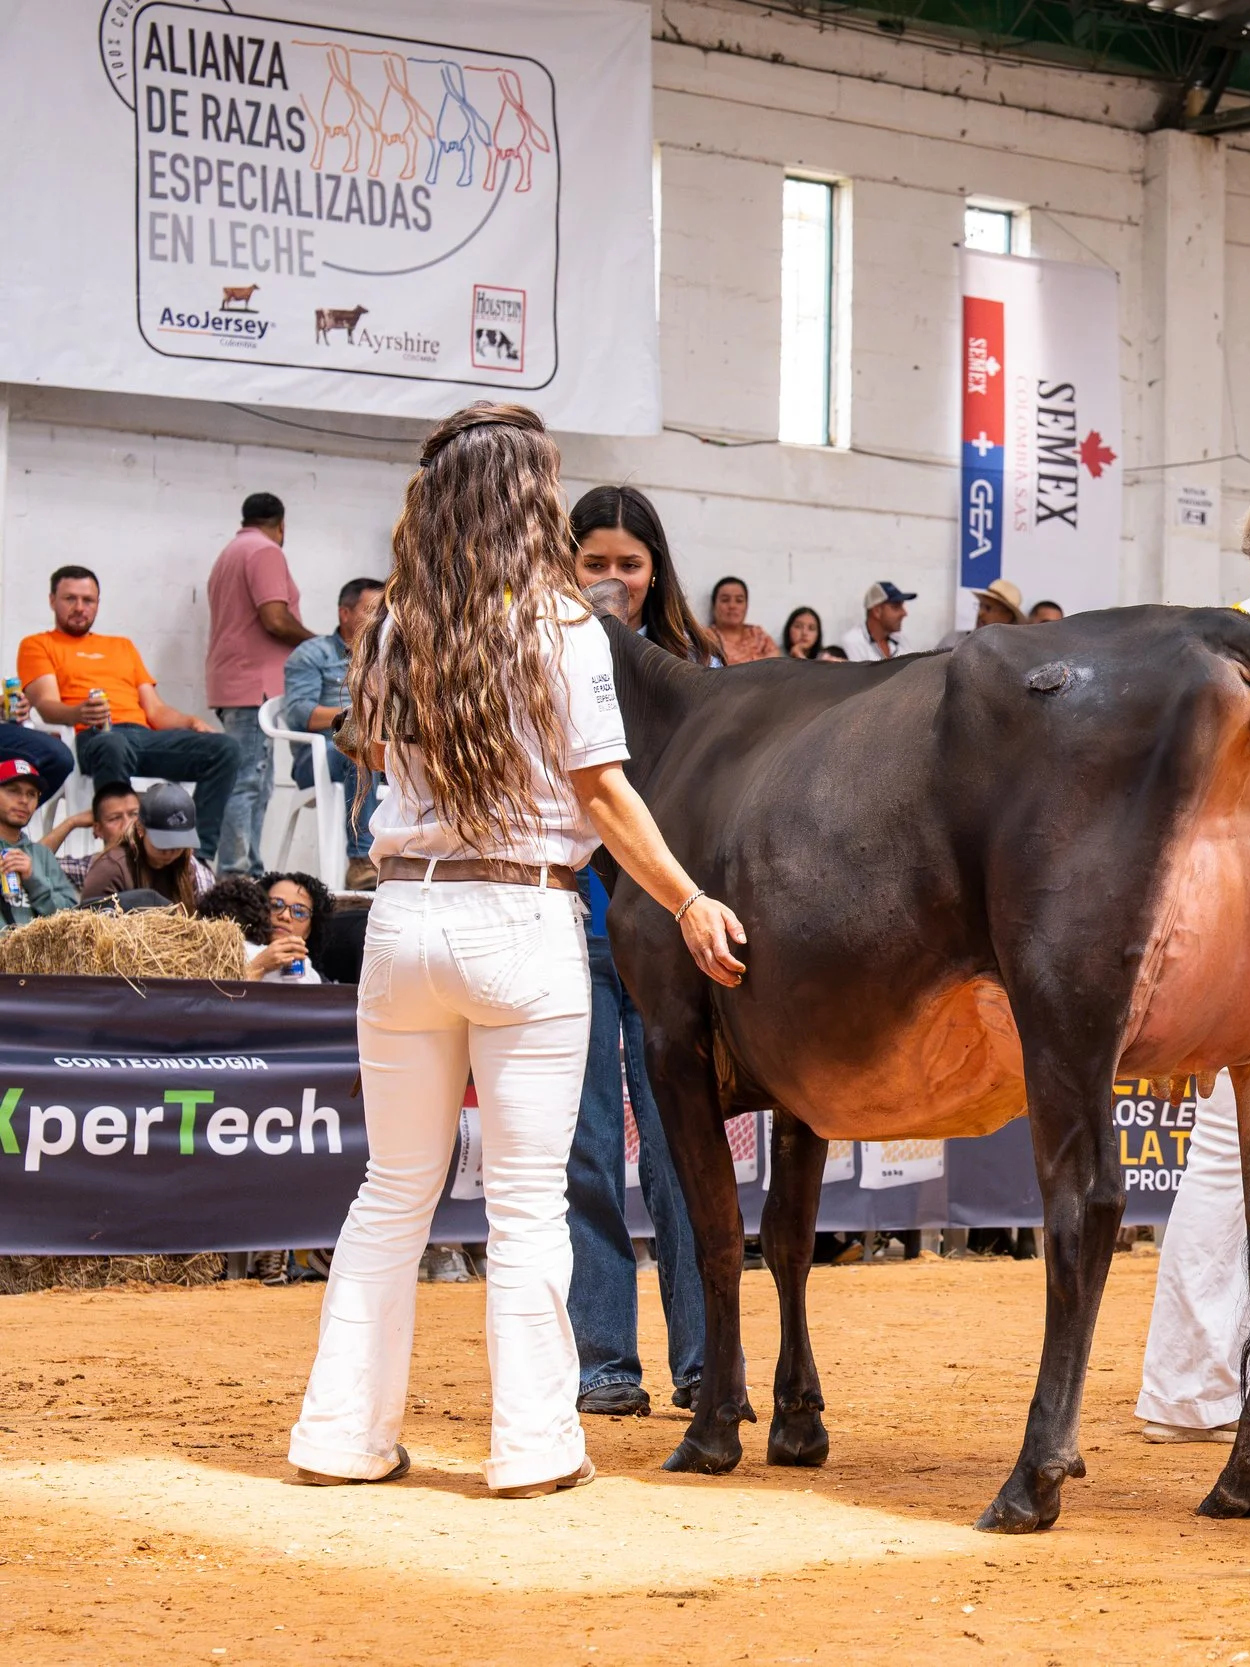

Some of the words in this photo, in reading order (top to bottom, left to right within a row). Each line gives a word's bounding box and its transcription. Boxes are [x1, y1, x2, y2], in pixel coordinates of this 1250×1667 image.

[143, 21, 289, 91] ALIANZA
[146, 85, 189, 138] DE
[201, 93, 306, 153] RAZAS
[149, 149, 432, 232] ESPECIALIZADAS
[149, 211, 194, 264] EN
[208, 218, 316, 278] LECHE
[160, 307, 269, 340] AsoJersey
[357, 328, 440, 353] Ayrshire
[968, 337, 987, 396] SEMEX
[1014, 375, 1030, 482] COLOMBIA
[1036, 379, 1078, 531] SEMEX
[968, 478, 993, 560] GEA
[54, 1057, 111, 1069] CON
[1112, 1100, 1156, 1127] OS
[1160, 1101, 1197, 1127] LE
[1120, 1130, 1164, 1166] LA
[1169, 1130, 1191, 1166] T
[1125, 1169, 1184, 1191] PROD
